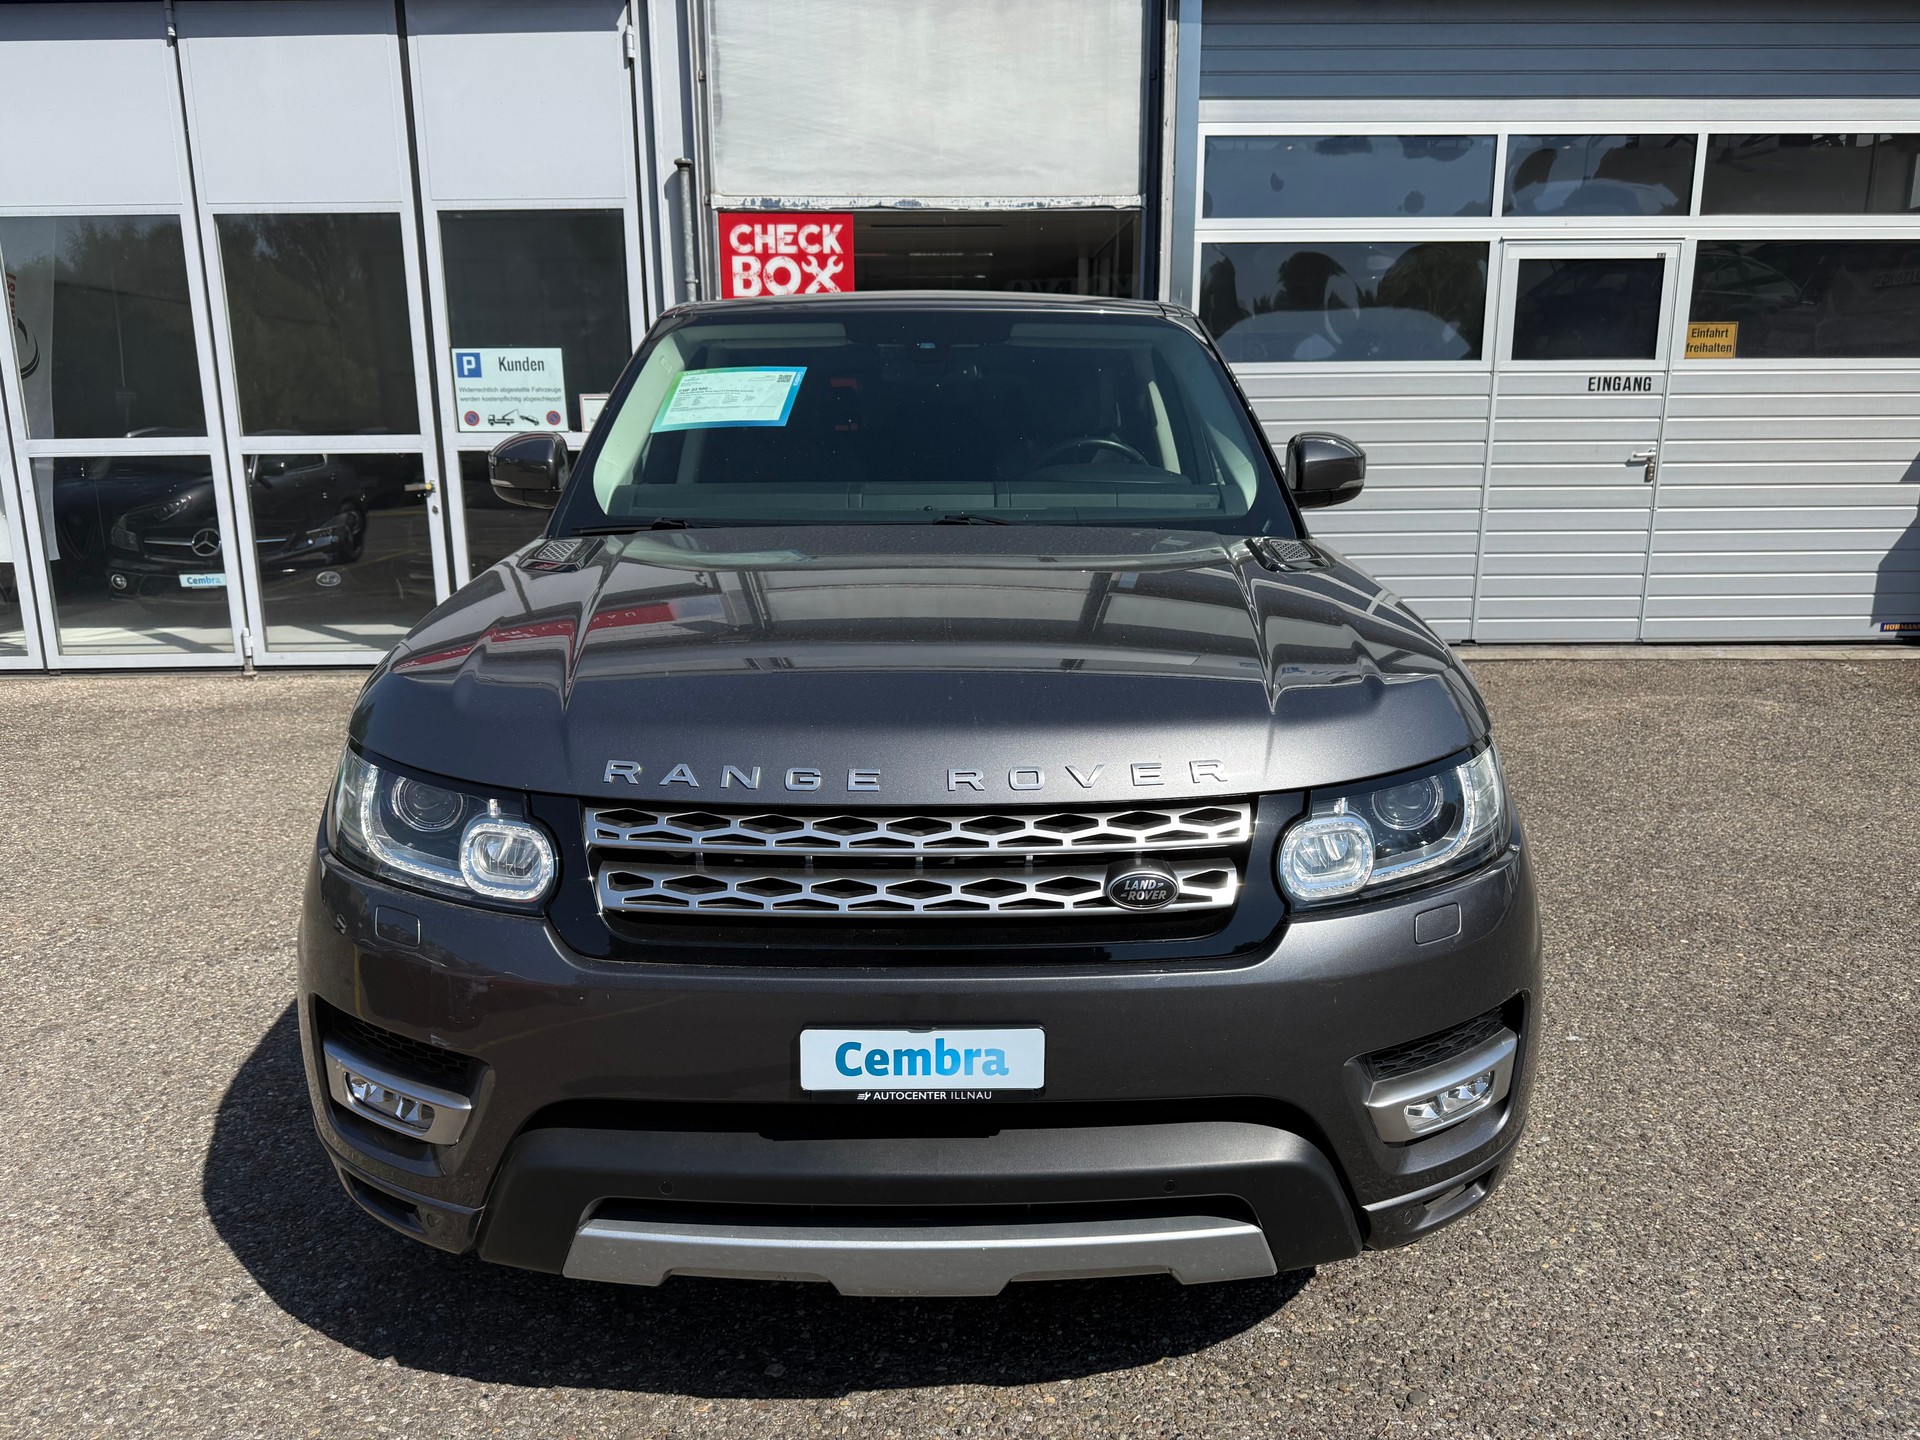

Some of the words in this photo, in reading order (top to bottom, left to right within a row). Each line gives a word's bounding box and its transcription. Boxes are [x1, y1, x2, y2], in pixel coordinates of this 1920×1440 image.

[729, 224, 844, 254] CHECK
[731, 255, 844, 297] BOX
[1691, 328, 1729, 338] Einfahrt
[1685, 342, 1732, 353] freihalten
[462, 356, 476, 375] P
[498, 357, 545, 372] Kunden
[1588, 376, 1652, 392] EINGANG
[500, 387, 530, 395] abgestellte
[481, 395, 523, 404] kostenpflichtig
[186, 576, 221, 585] Cembra
[602, 759, 881, 793] RANGE
[946, 758, 1229, 793] ROVER
[1124, 879, 1157, 890] LAND
[1127, 890, 1167, 900] ROVER
[834, 1037, 1010, 1077] Cembra
[873, 1091, 947, 1101] AUTOCENTER
[950, 1091, 992, 1100] ILLNAU
